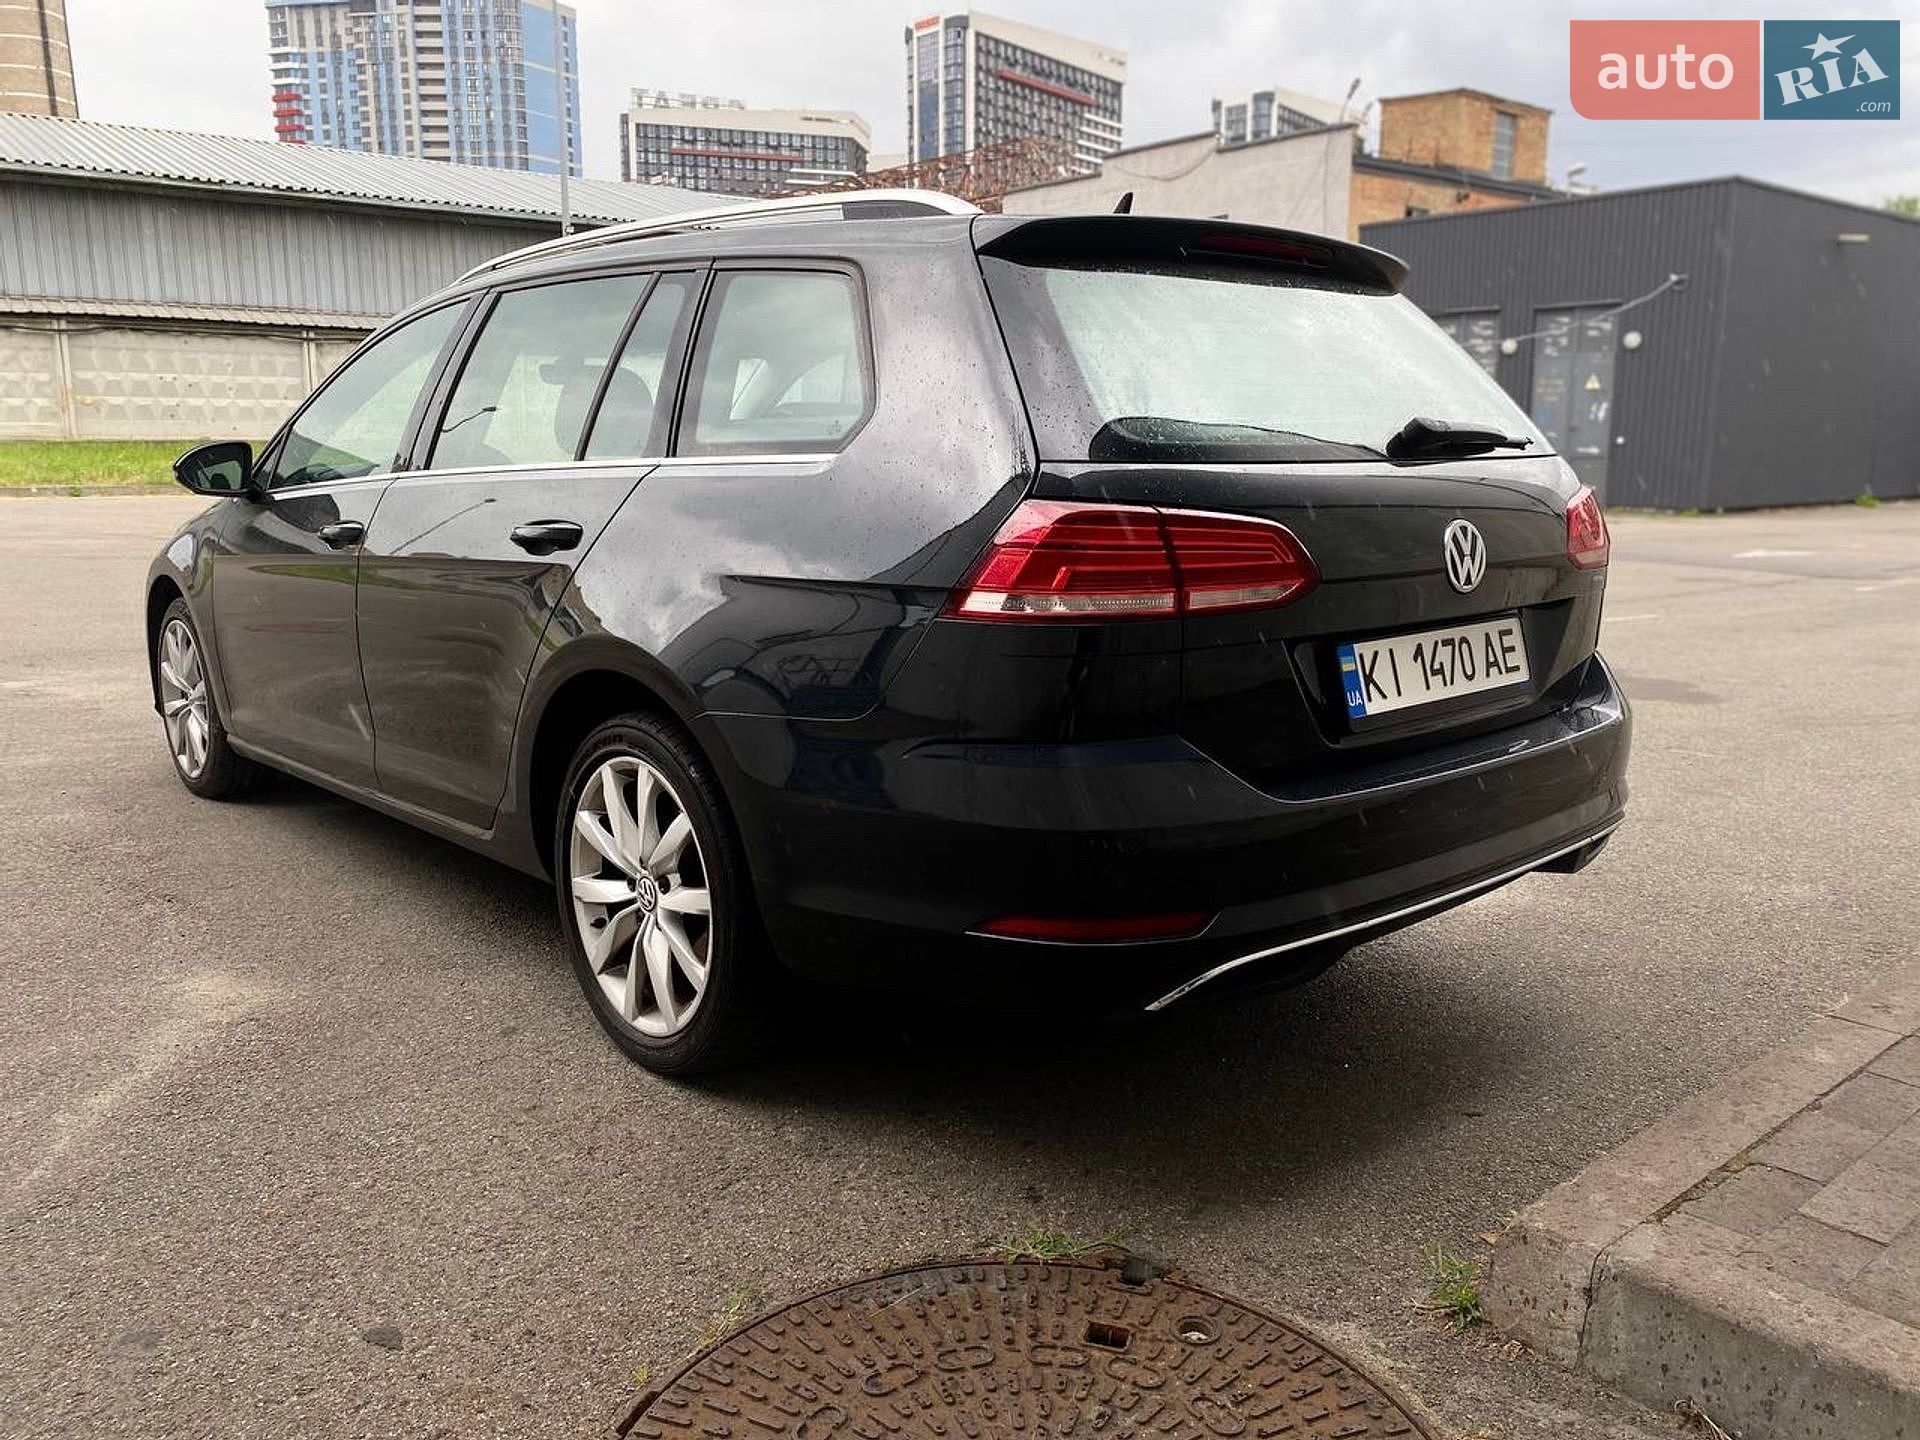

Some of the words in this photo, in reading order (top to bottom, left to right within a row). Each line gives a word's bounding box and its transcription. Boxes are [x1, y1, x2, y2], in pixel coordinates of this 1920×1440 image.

[1358, 647, 1402, 703] KI
[1412, 635, 1476, 691] 1470
[1484, 628, 1521, 679] AE
[1346, 691, 1363, 707] UA
